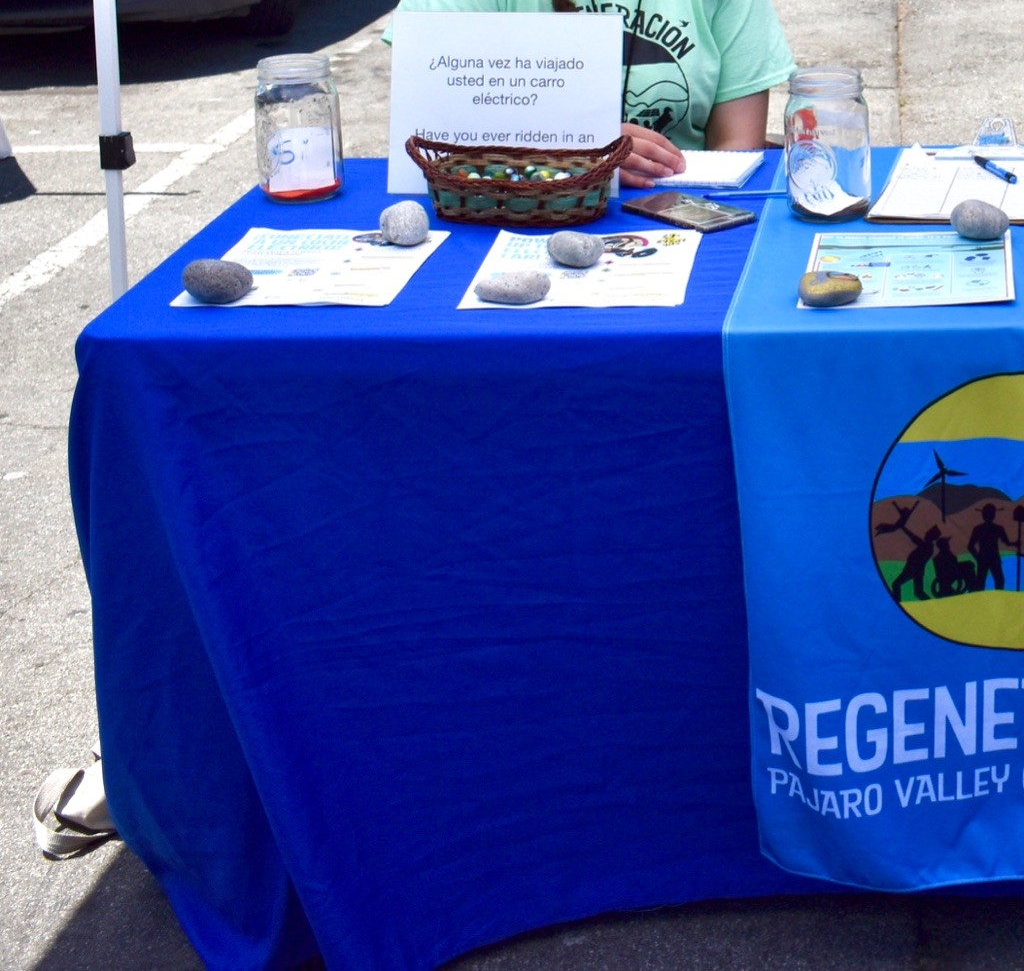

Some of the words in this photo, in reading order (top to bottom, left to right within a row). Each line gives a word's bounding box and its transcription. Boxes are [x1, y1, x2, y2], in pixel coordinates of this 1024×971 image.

[429, 56, 484, 71] ¿Alguna
[488, 59, 511, 69] vez
[515, 57, 532, 69] ha
[536, 57, 584, 72] viajado
[447, 75, 484, 87] usted
[489, 77, 505, 87] en
[509, 78, 526, 87] un
[530, 78, 565, 88] carro
[472, 93, 538, 106] eléctrico?
[415, 128, 449, 141] Have
[453, 131, 478, 144] you
[482, 131, 511, 143] ever
[515, 129, 558, 143] ridden
[562, 130, 574, 143] in
[578, 132, 595, 144] an
[767, 767, 884, 819] PAJARO
[894, 764, 1011, 809] VALLEY
